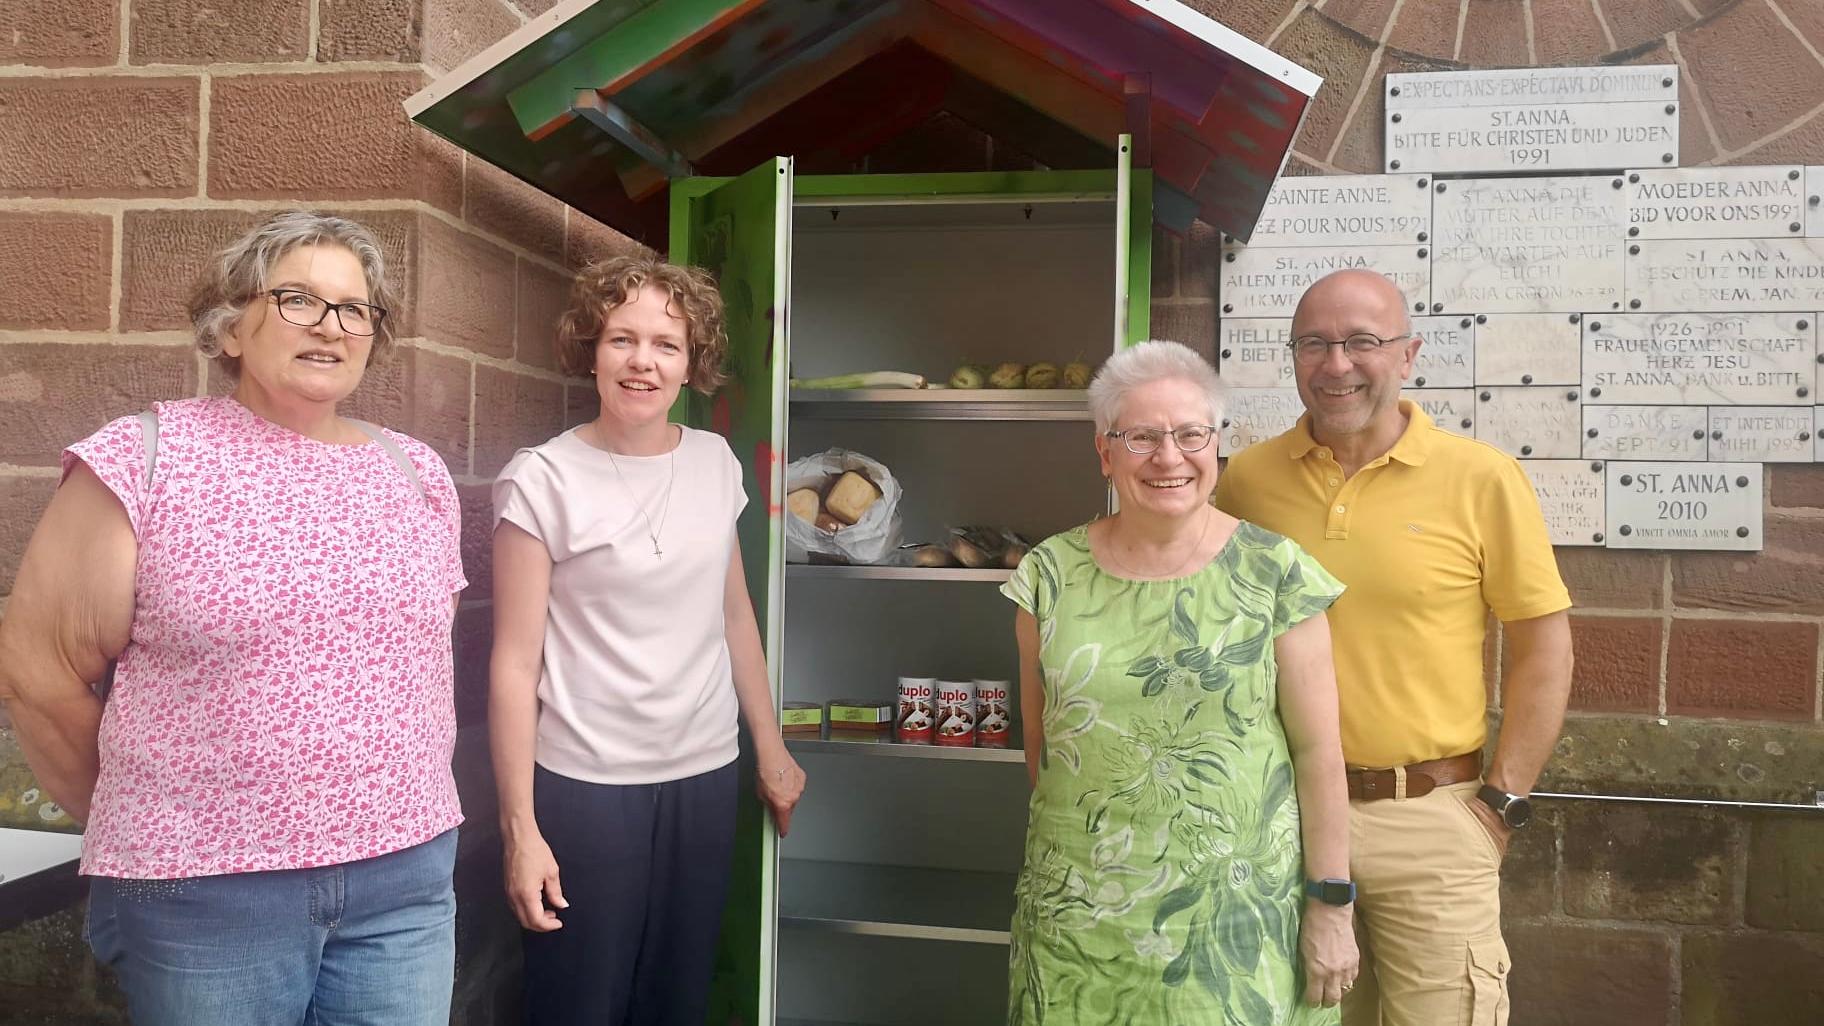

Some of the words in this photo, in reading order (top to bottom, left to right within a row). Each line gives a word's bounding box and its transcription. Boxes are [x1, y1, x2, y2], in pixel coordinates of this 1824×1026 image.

[1394, 132, 1441, 148] BITTE
[1447, 127, 1481, 147] FÜR
[1486, 128, 1567, 146] CHRISTEN
[1571, 127, 1608, 144] UND
[1616, 125, 1673, 143] JUDEN
[1510, 148, 1550, 164] 1991
[1268, 186, 1329, 205] SAINTE
[1637, 183, 1730, 200] MOEDER
[1447, 208, 1521, 224] MUTTER
[1528, 207, 1565, 221] AUF
[1629, 207, 1659, 223] BID
[1663, 205, 1717, 222] VOOR
[1720, 204, 1760, 220] ONS
[1763, 204, 1799, 219] 1991
[1283, 218, 1331, 235] POUR
[1389, 216, 1427, 232] 1991
[1479, 246, 1569, 261] WARTEN
[1575, 244, 1617, 259] AUF
[1737, 265, 1770, 280] DIE
[1225, 274, 1276, 289] ALLEN
[1228, 329, 1291, 343] HELLE
[1415, 331, 1458, 345] NKE
[1594, 338, 1808, 352] FRAUENGEMEINSCHAFT
[1241, 347, 1280, 362] BIET
[1646, 354, 1696, 369] HERZ
[1703, 354, 1751, 369] JESU
[1594, 372, 1619, 387] ST.
[1607, 413, 1682, 430] DANKE
[1737, 416, 1809, 430] INTENDIT
[1669, 437, 1689, 452] 91
[1636, 474, 1664, 494] ST.
[1671, 473, 1730, 493] ANNA
[1657, 501, 1708, 521] 2010
[1635, 527, 1665, 537] VINCIT
[1667, 527, 1698, 538] OMNIA
[1702, 527, 1729, 538] AMOR
